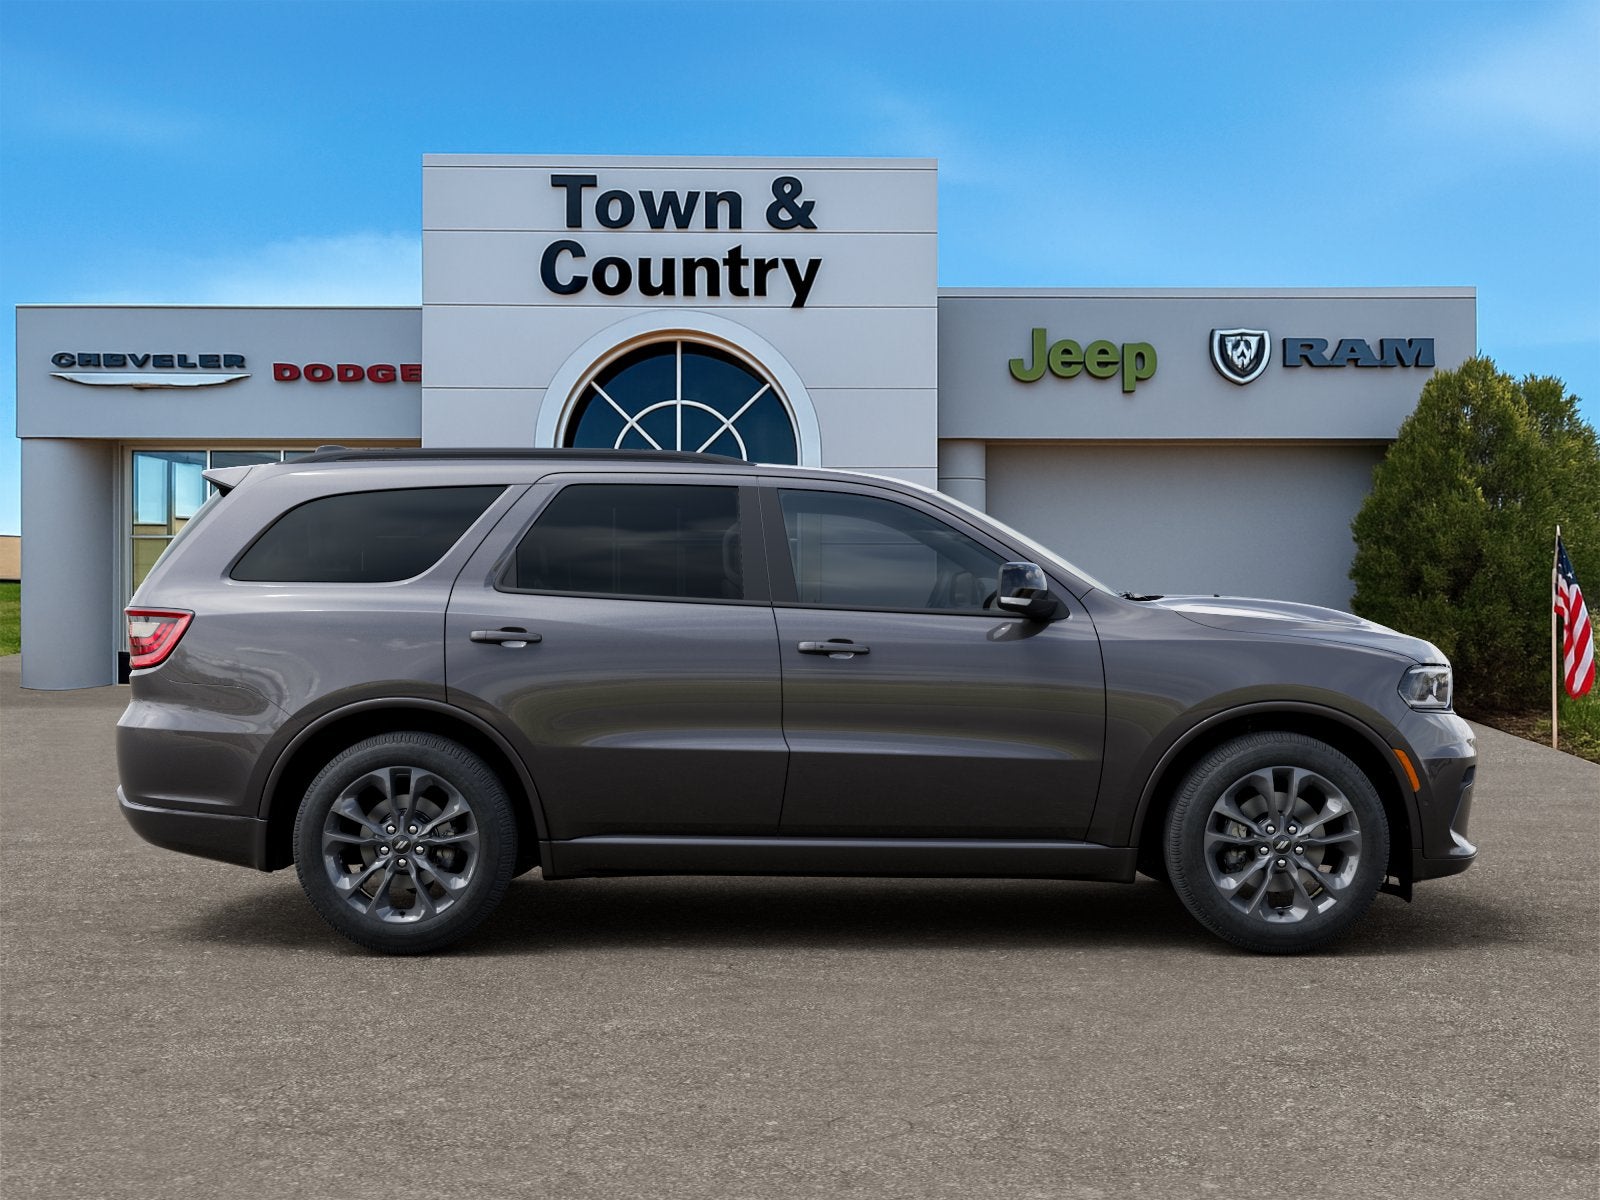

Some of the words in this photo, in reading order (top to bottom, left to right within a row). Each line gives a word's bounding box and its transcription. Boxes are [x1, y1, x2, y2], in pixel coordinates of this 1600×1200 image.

[550, 174, 742, 229] Town
[765, 176, 818, 229] &
[540, 239, 822, 308] Country
[1008, 327, 1158, 393] Jeep
[1283, 337, 1435, 367] RAM
